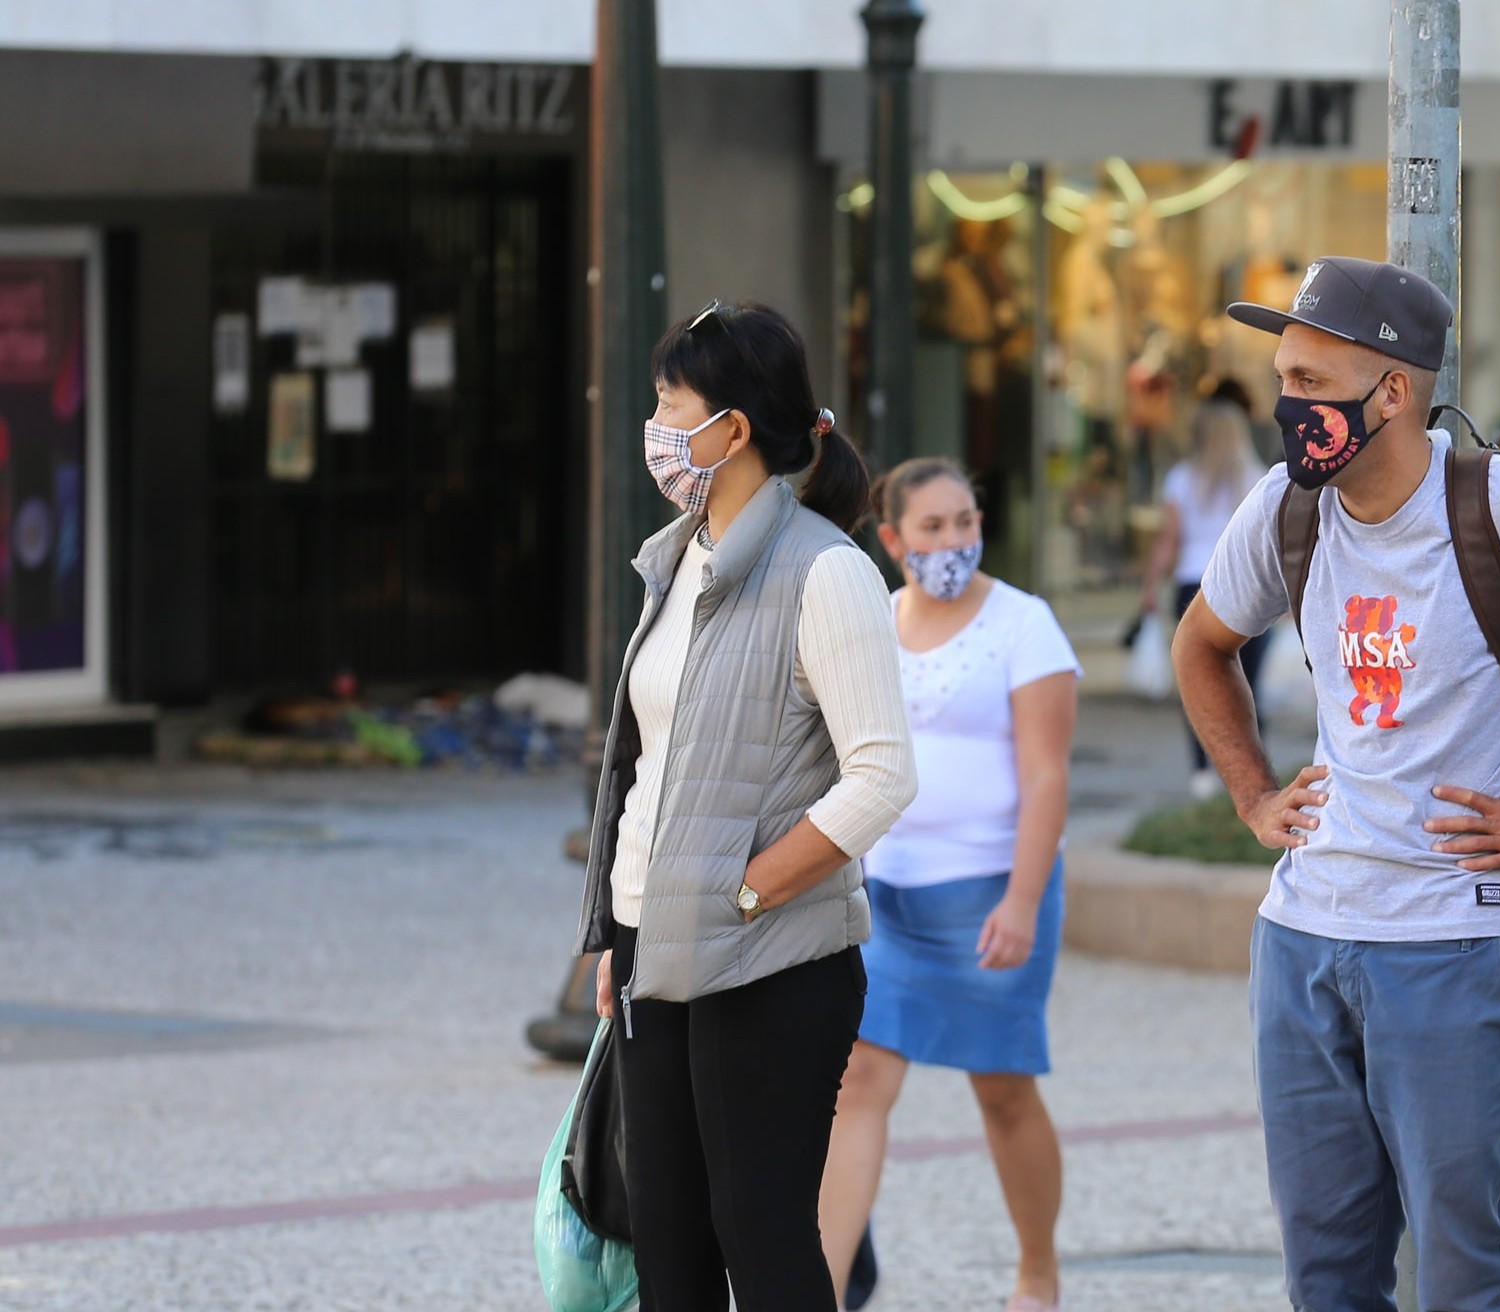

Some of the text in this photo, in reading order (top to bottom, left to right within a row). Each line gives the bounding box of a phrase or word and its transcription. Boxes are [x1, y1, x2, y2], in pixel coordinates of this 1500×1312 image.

[462, 64, 575, 133] RITZ
[1270, 80, 1357, 147] ART
[1338, 630, 1416, 669] MSA
